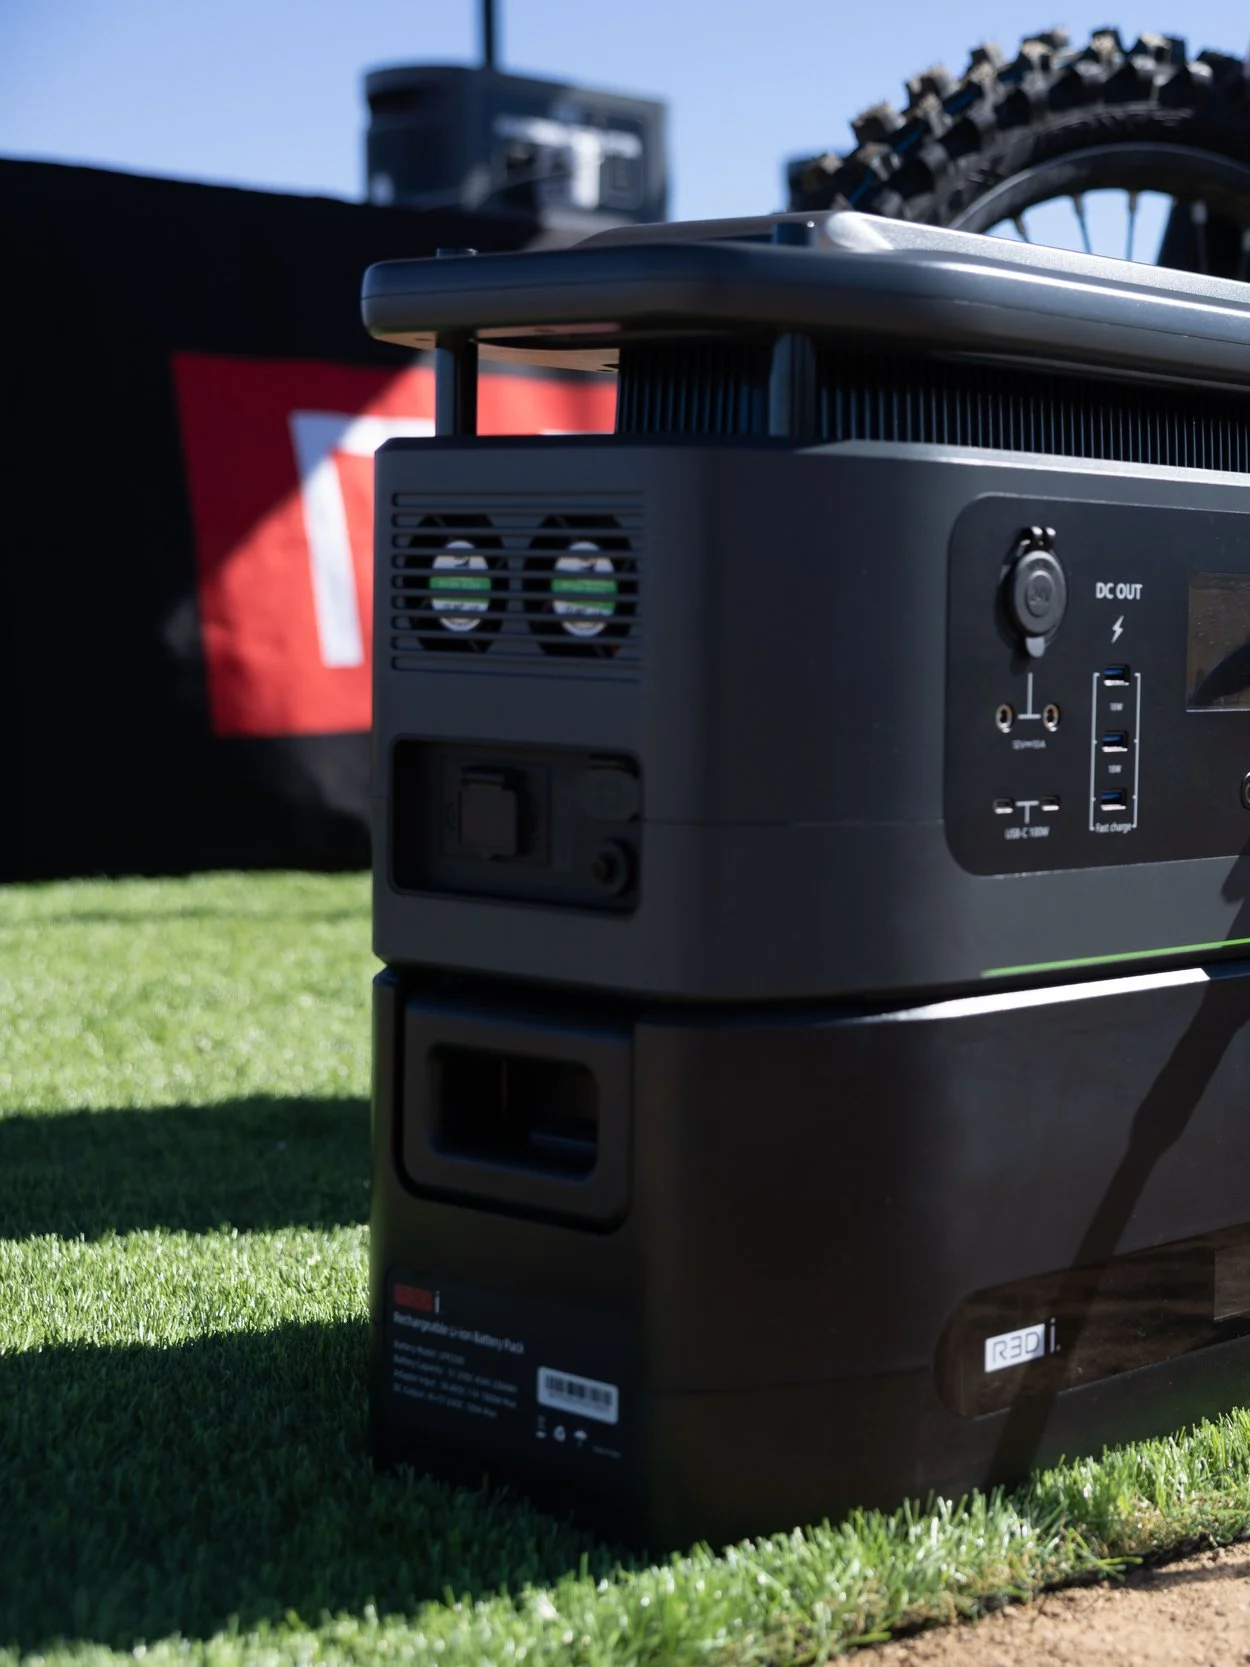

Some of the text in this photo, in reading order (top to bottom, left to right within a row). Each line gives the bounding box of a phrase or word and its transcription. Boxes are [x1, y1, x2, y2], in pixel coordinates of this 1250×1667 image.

[1096, 581, 1143, 600] DC OUT
[1095, 821, 1132, 834] Fast charge
